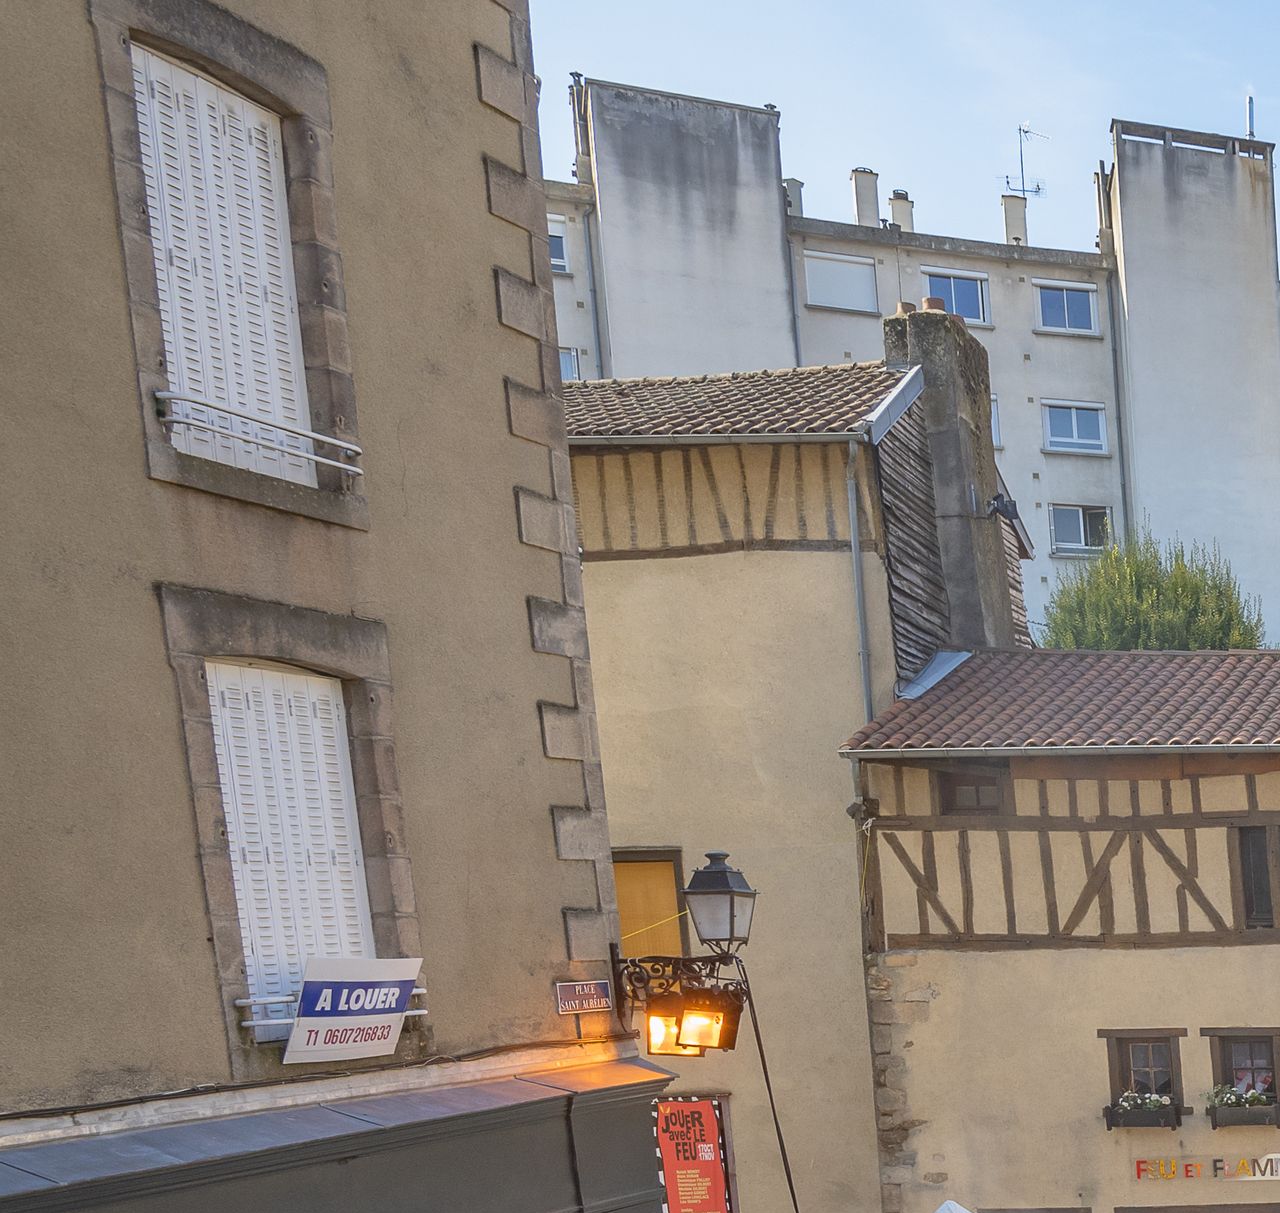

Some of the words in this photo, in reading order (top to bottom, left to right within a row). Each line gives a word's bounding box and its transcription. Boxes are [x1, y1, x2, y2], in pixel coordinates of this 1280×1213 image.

[575, 984, 596, 995] PLACE
[315, 988, 332, 1012] A
[338, 987, 400, 1011] LOUER
[560, 1000, 579, 1011] SAINT
[583, 995, 610, 1009] AURÉLIEN
[306, 1029, 319, 1046] T1
[324, 1024, 392, 1045] 0607216833
[693, 1128, 706, 1142] LE
[675, 1142, 697, 1161] FEU
[1135, 1157, 1177, 1180] FEU
[1184, 1163, 1204, 1179] ET
